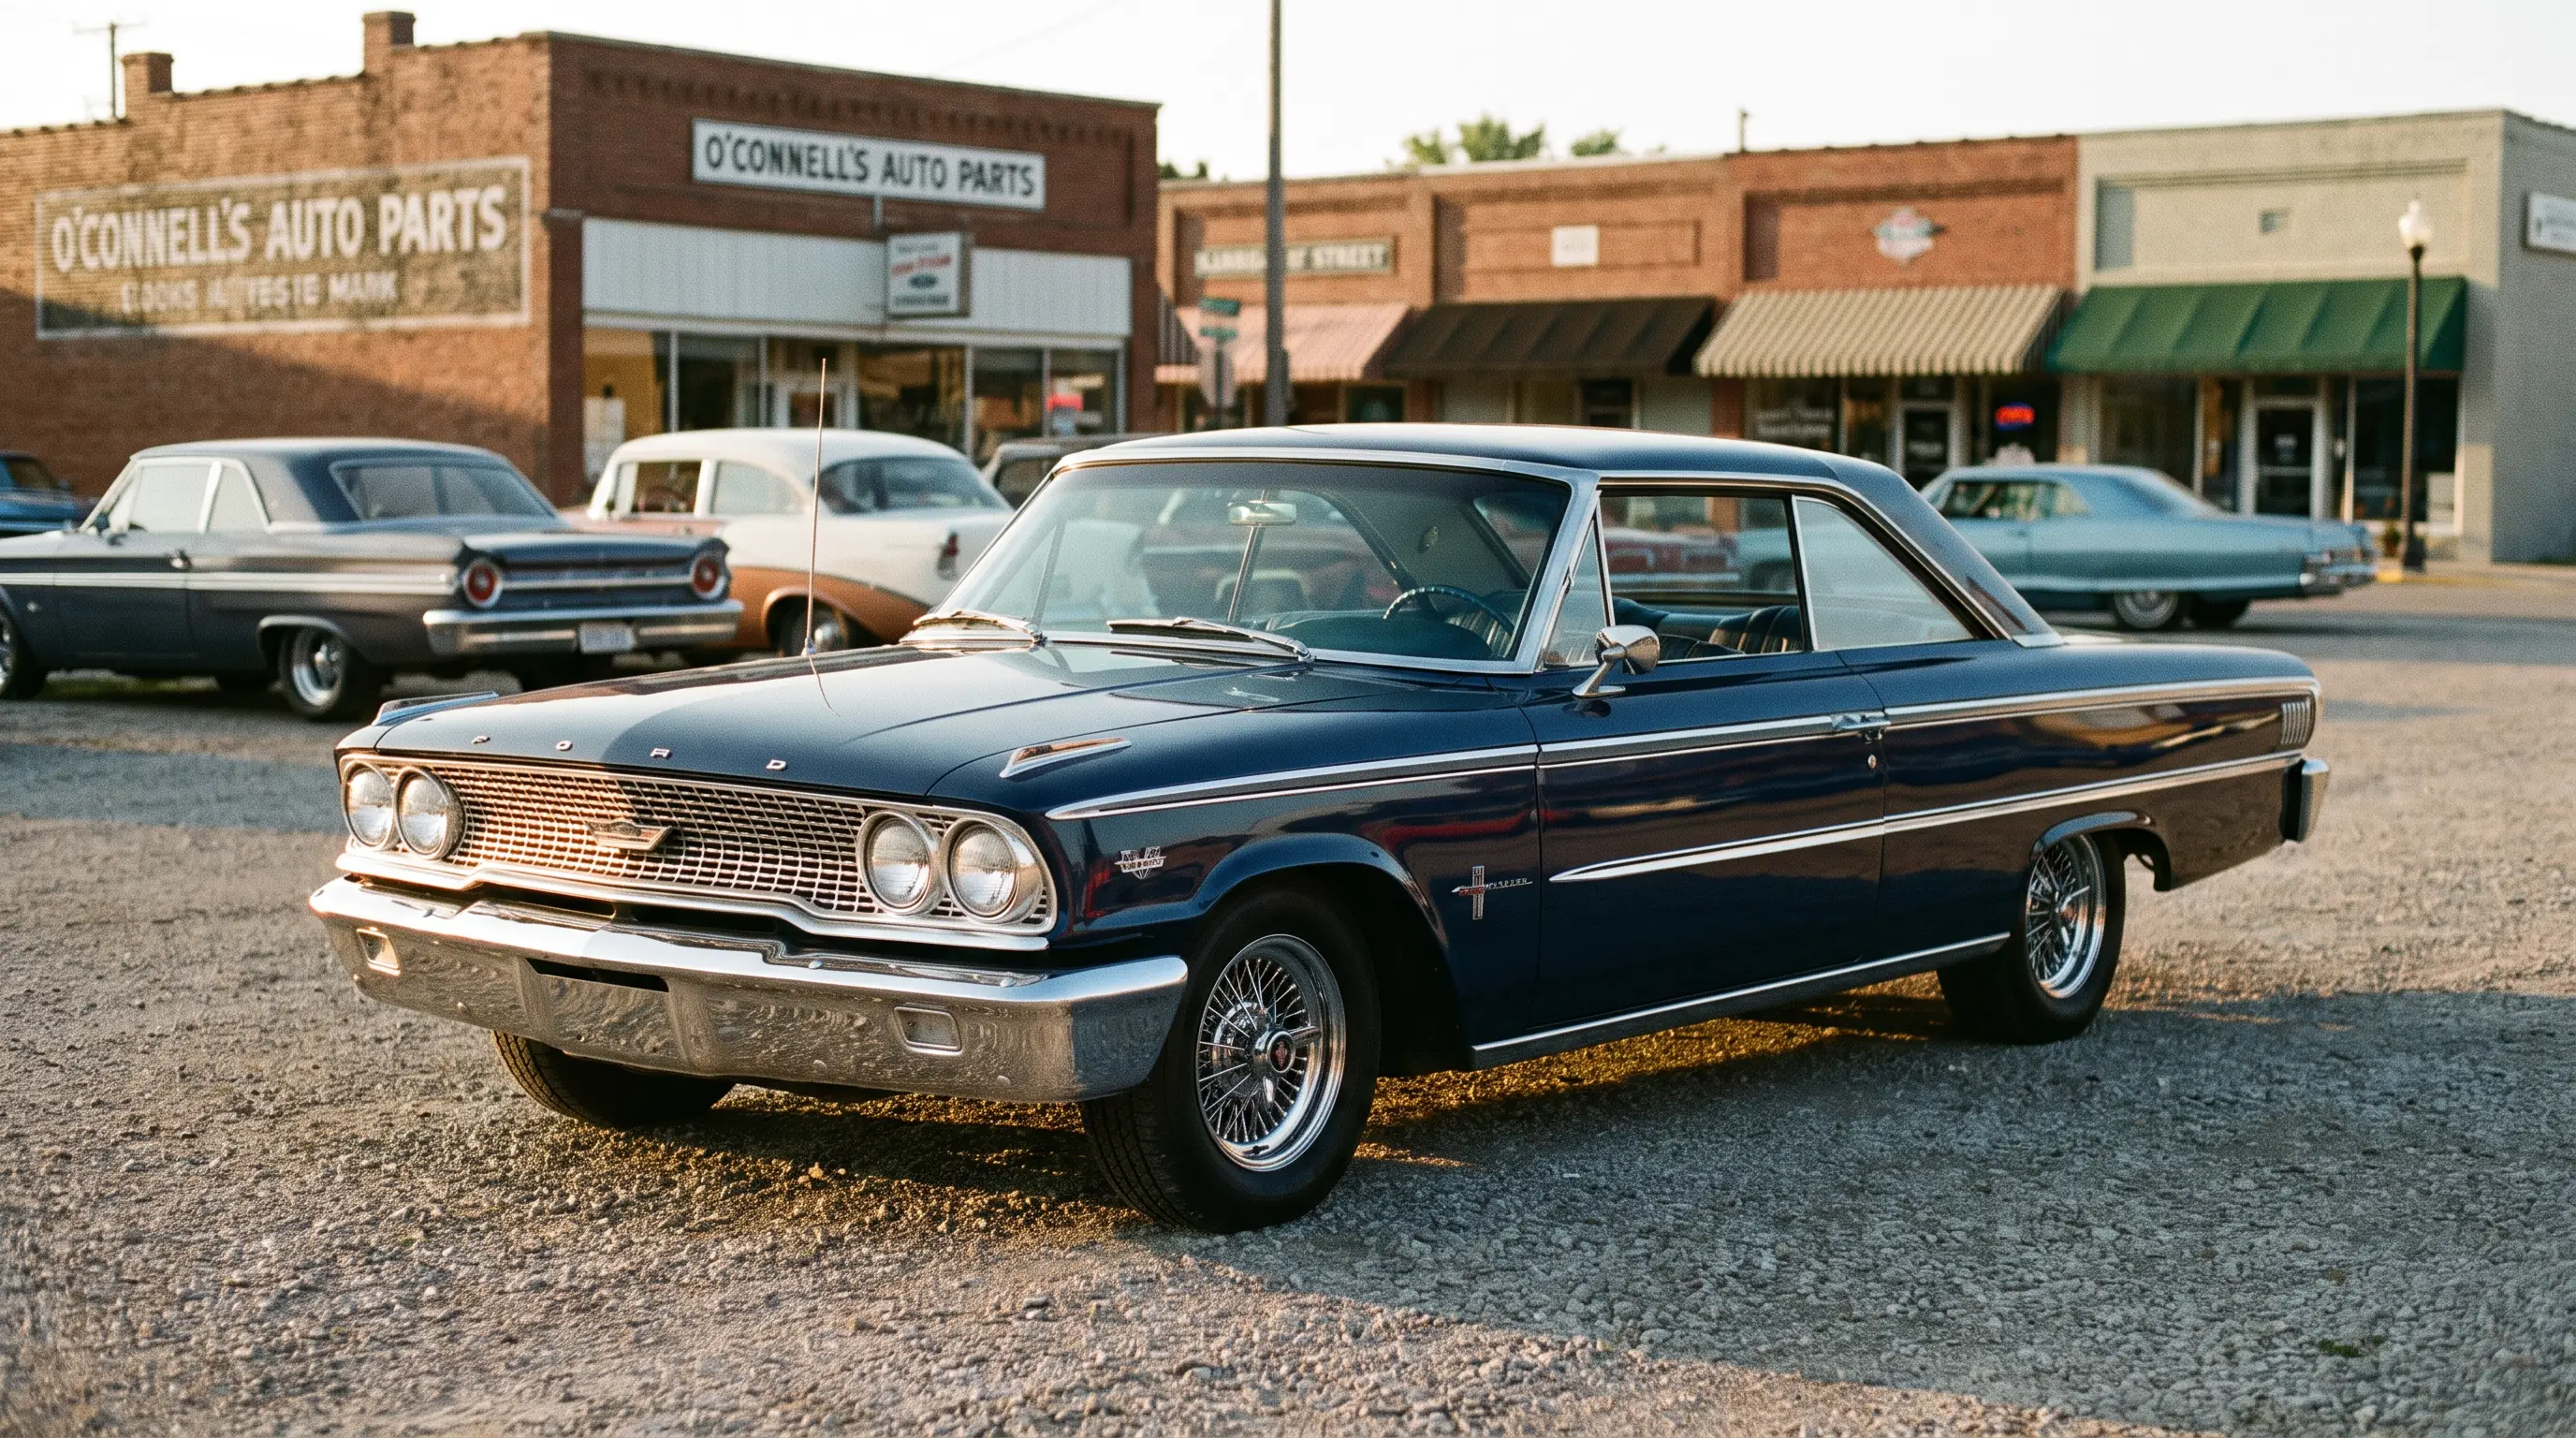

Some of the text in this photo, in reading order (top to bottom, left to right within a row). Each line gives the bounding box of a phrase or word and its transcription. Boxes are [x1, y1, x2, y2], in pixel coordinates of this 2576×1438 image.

[706, 132, 1033, 197] O'CONNELL'S AUTO PARTS
[52, 183, 506, 272] O'CONNELL'S AUTO PARTS
